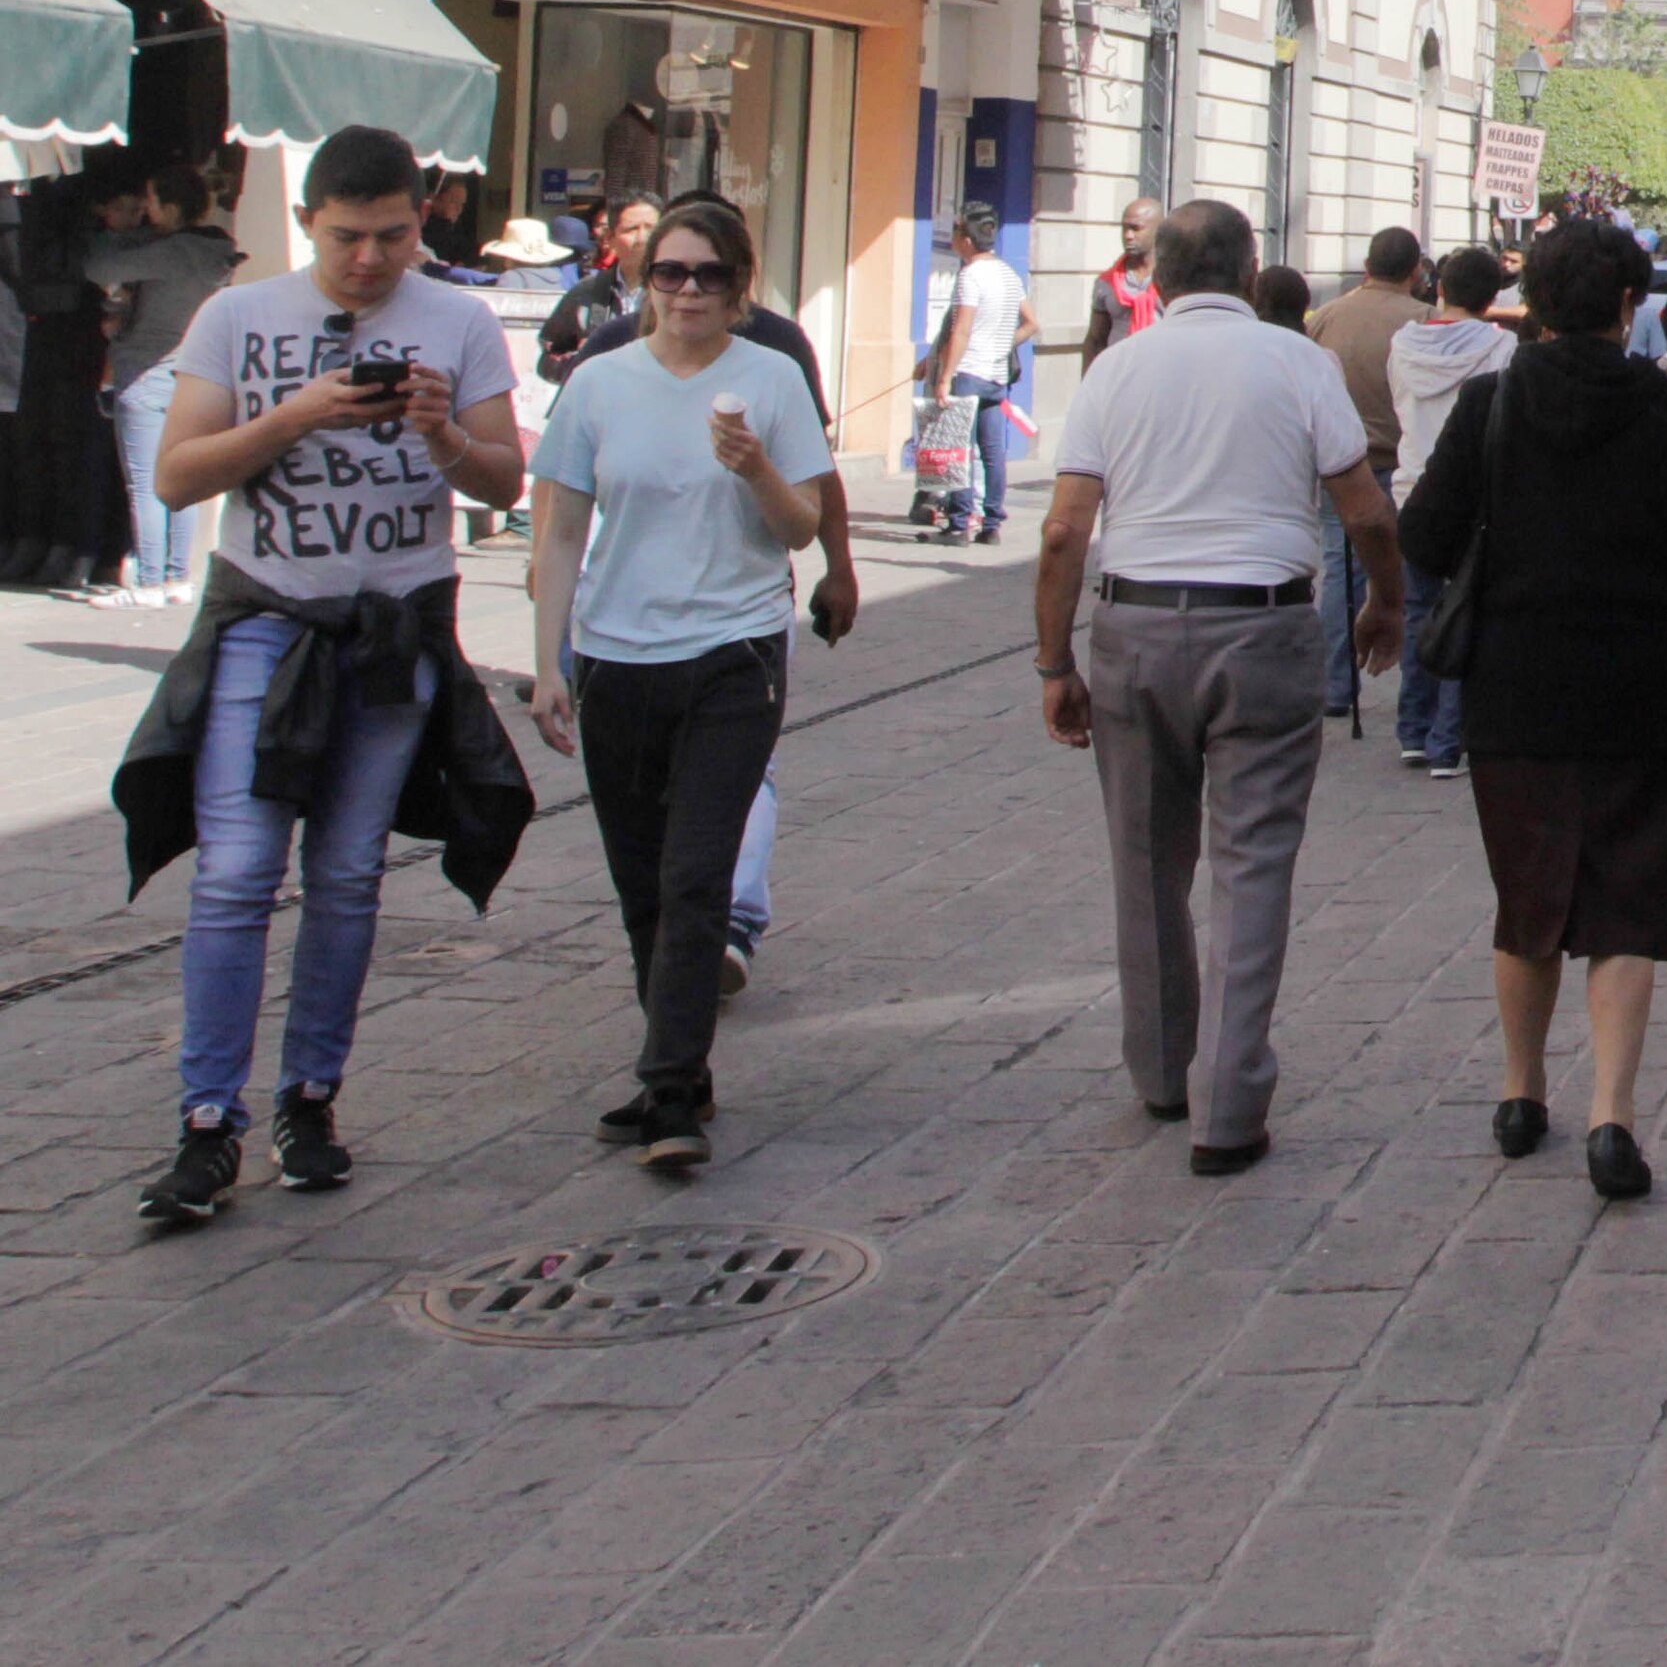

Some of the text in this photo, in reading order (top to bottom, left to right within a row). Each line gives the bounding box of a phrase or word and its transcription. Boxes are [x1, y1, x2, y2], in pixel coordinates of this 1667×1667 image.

[1488, 128, 1539, 149] HELADOS
[1486, 162, 1529, 179] FRAPPES
[1486, 177, 1524, 195] CREPAS
[240, 332, 422, 381] REFSE
[254, 502, 435, 559] REVOLT
